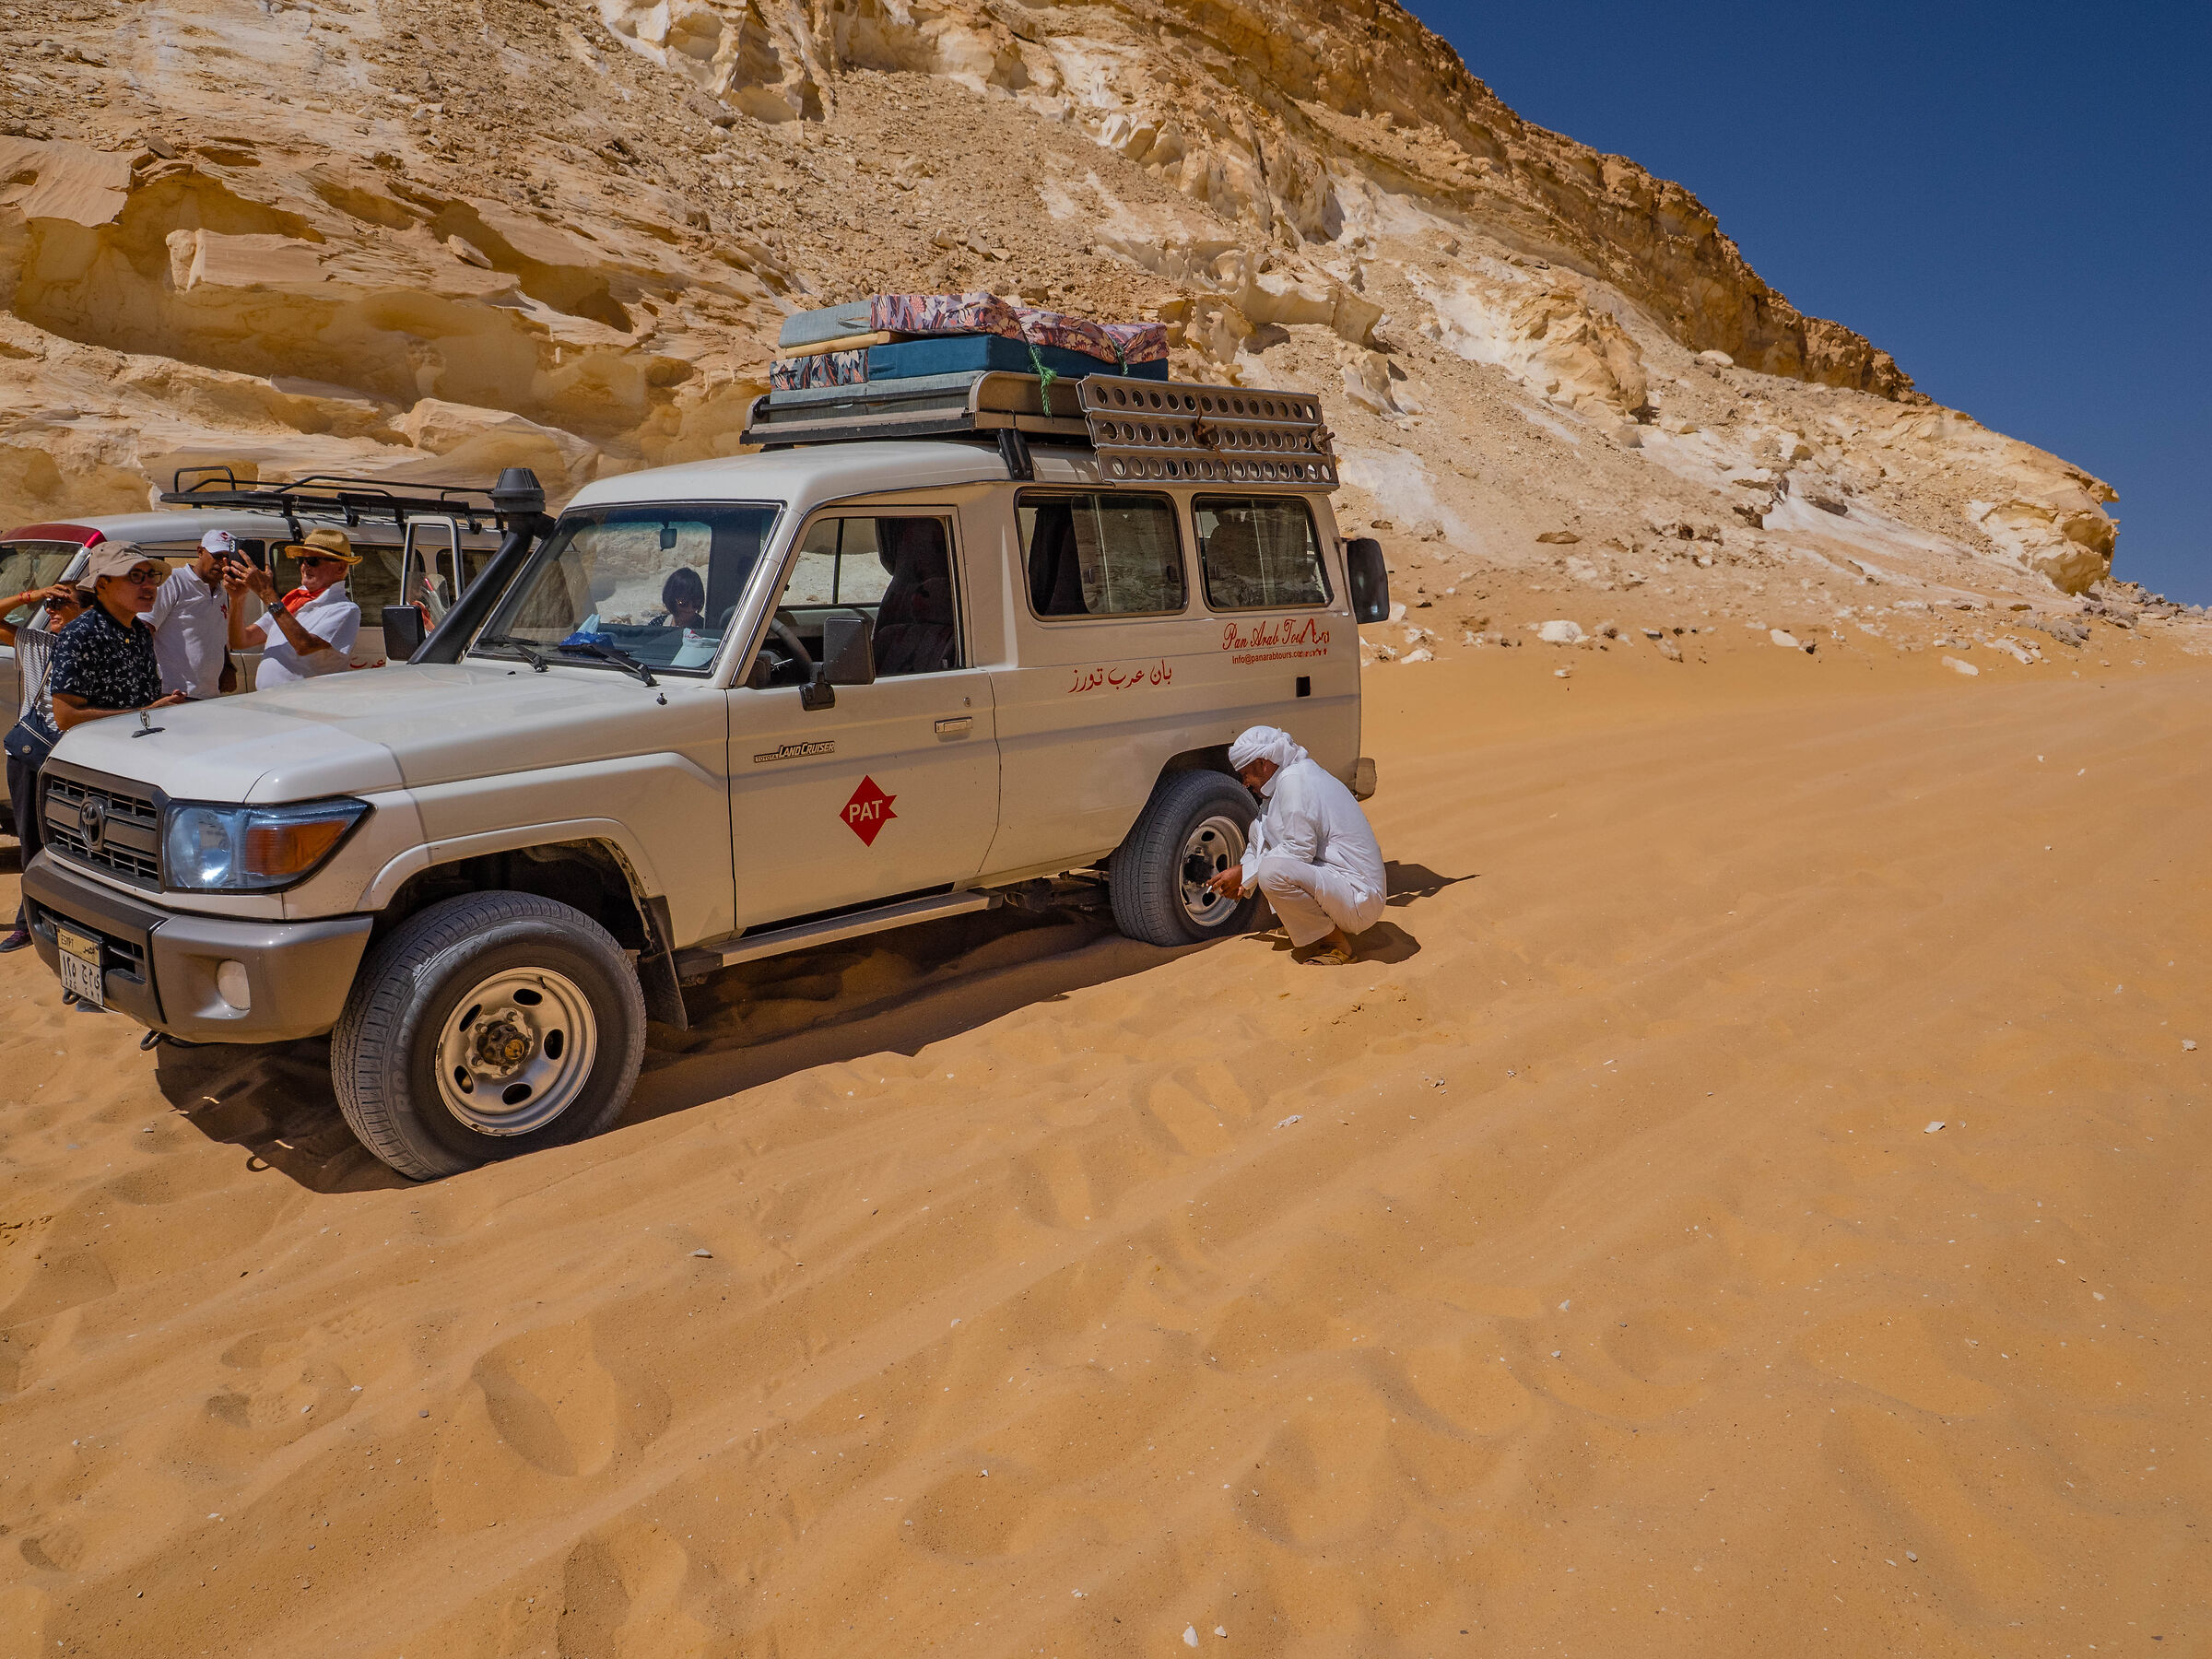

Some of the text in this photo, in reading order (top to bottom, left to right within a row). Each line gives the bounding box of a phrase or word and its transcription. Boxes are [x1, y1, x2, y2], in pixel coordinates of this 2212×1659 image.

[1222, 623, 1248, 650] Pan
[1250, 620, 1279, 647] Arab
[1067, 658, 1172, 693] بان عرب تورز
[849, 799, 883, 823] PAT
